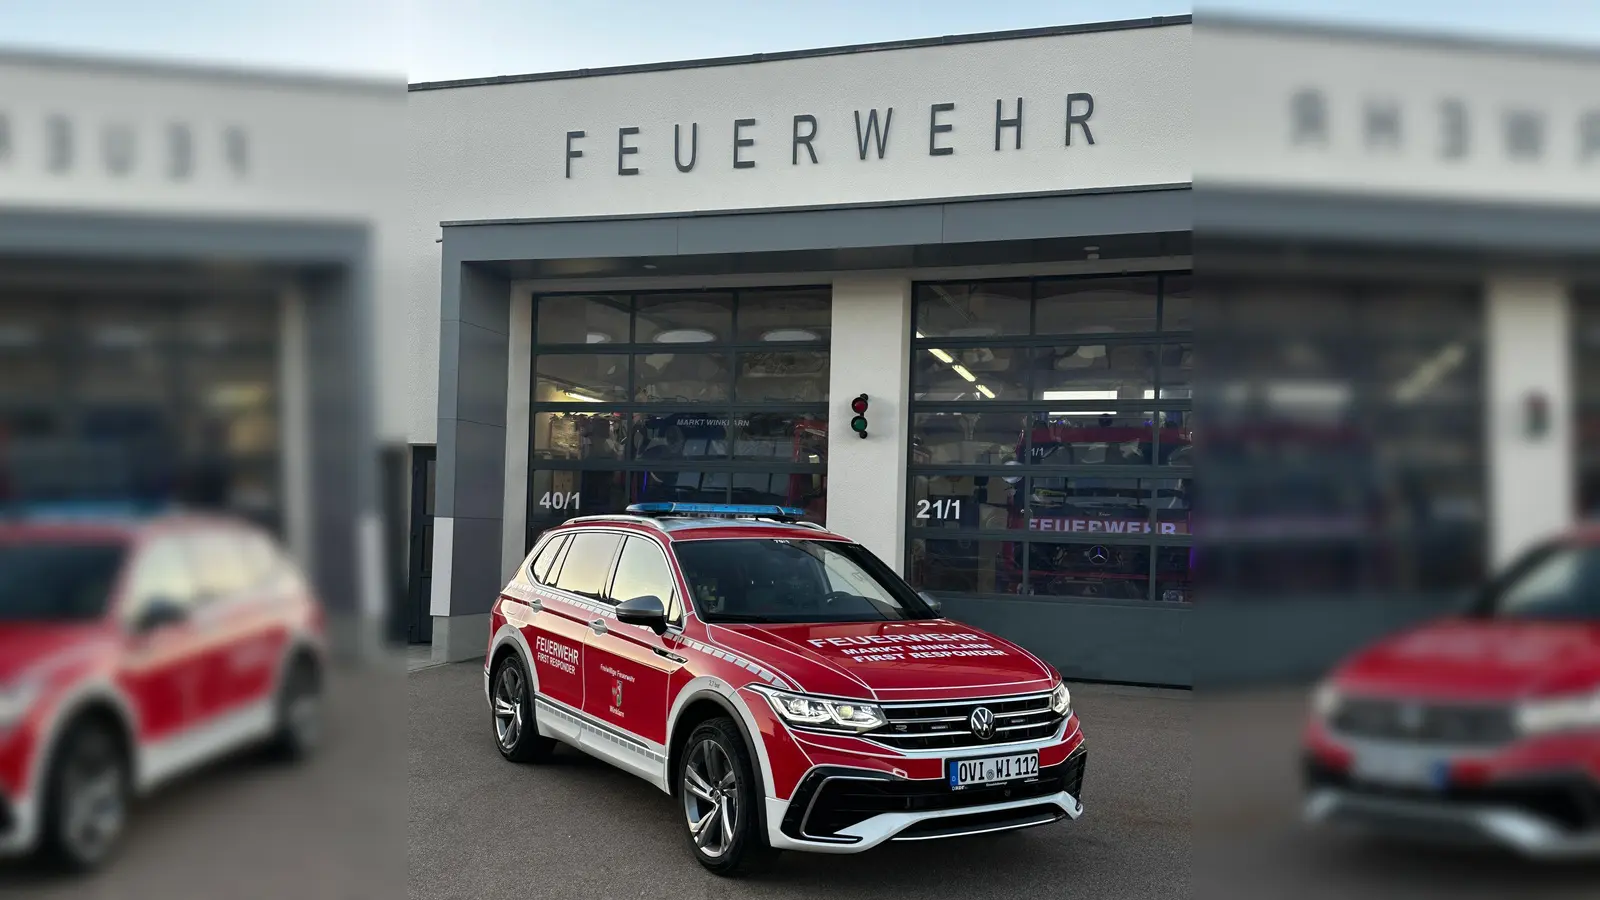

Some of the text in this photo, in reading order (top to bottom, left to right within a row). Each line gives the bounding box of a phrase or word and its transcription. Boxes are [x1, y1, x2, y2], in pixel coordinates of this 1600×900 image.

[564, 92, 1096, 179] FEUERWEHR
[676, 418, 706, 426] MARKT
[1024, 447, 1044, 457] 1/1
[539, 491, 581, 511] 40/1
[916, 499, 961, 519] 21/1
[536, 635, 579, 666] FEUERWEHR
[806, 633, 988, 649] FEUERWEHR
[841, 643, 995, 656] MARKT WINKLARN
[537, 653, 576, 676] FIRST RESPONDER
[852, 650, 1010, 663] FIRST RESPONDER
[959, 755, 1038, 782] OVI WI 112
